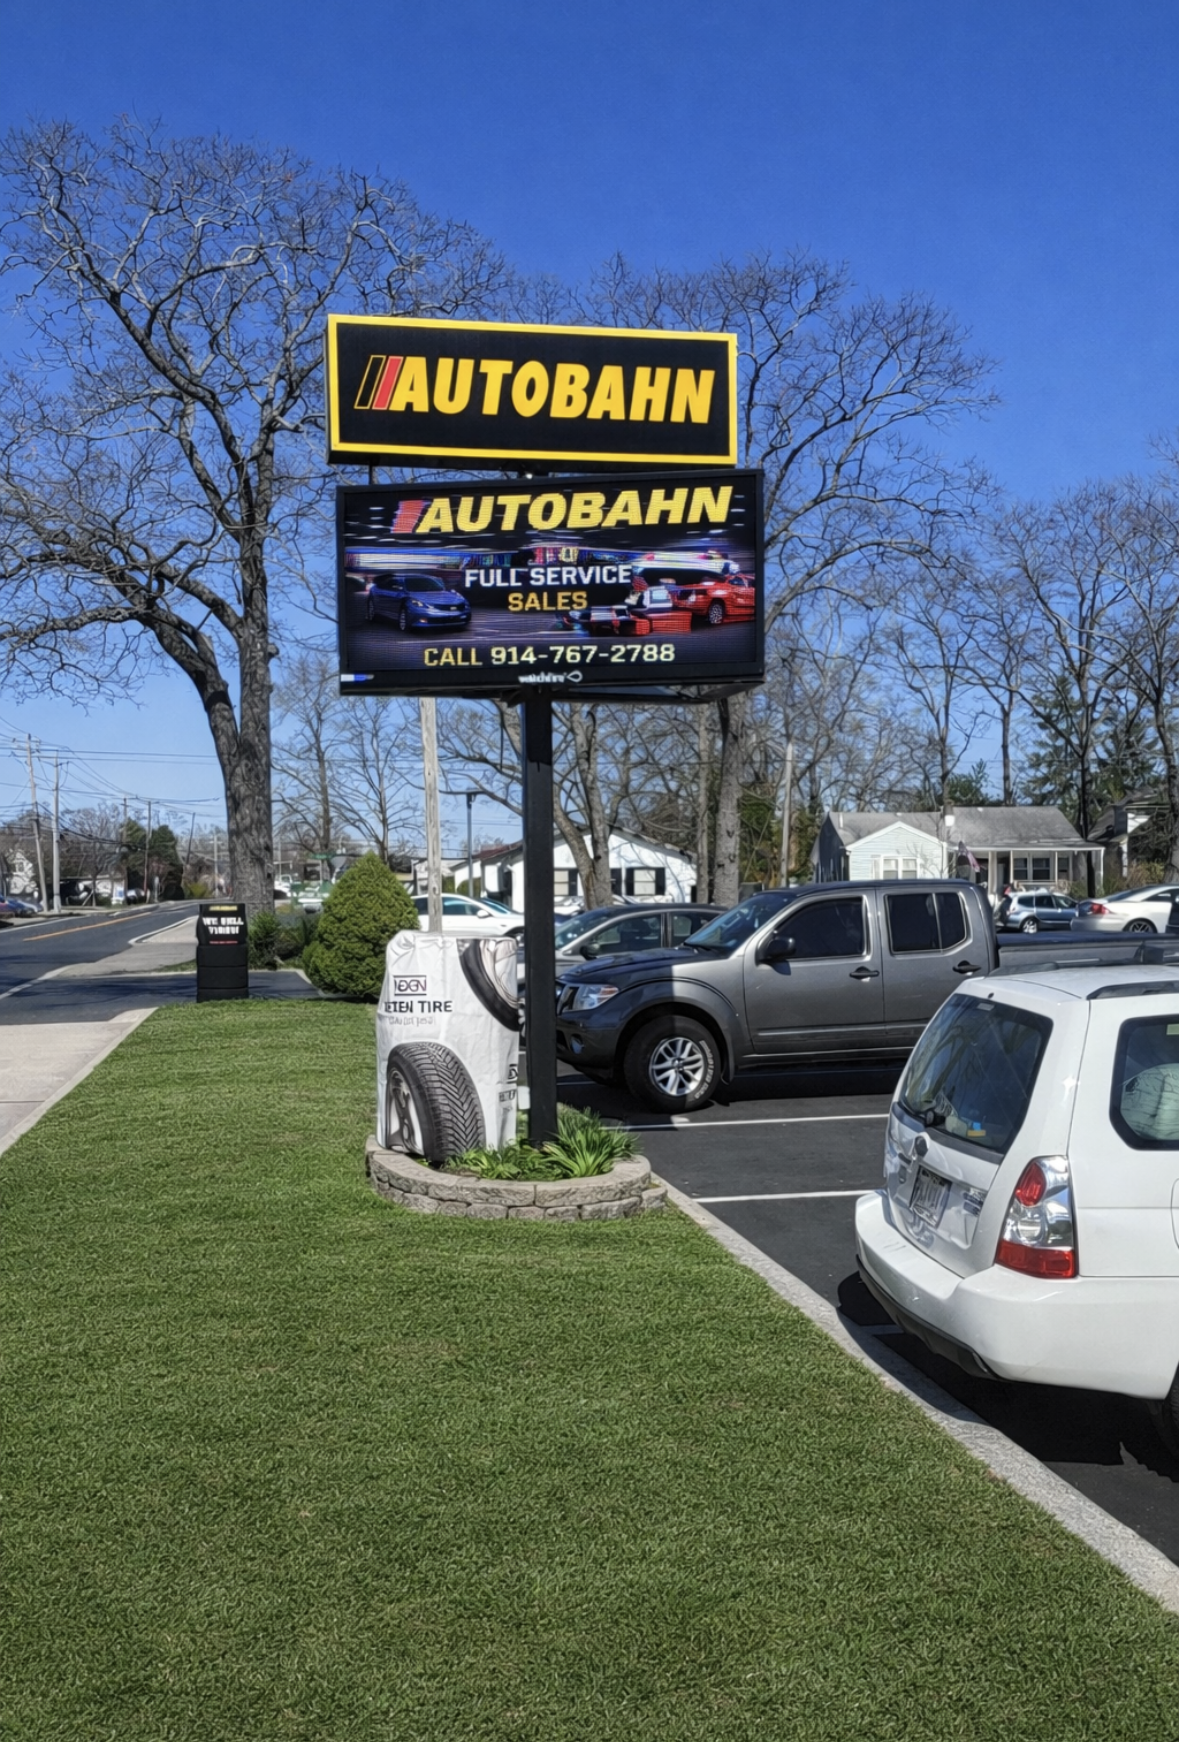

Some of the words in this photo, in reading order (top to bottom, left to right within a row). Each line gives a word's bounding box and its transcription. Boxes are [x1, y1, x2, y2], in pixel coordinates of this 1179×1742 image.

[389, 356, 715, 423] AUTOBAHN
[415, 486, 733, 533] AUTOBAHN
[464, 568, 526, 588] FULL
[529, 565, 632, 586] SERVICE
[508, 591, 588, 612] SALES
[424, 647, 483, 667] CALL
[490, 644, 676, 665] 914-767-2788
[418, 1001, 453, 1013] TIRE
